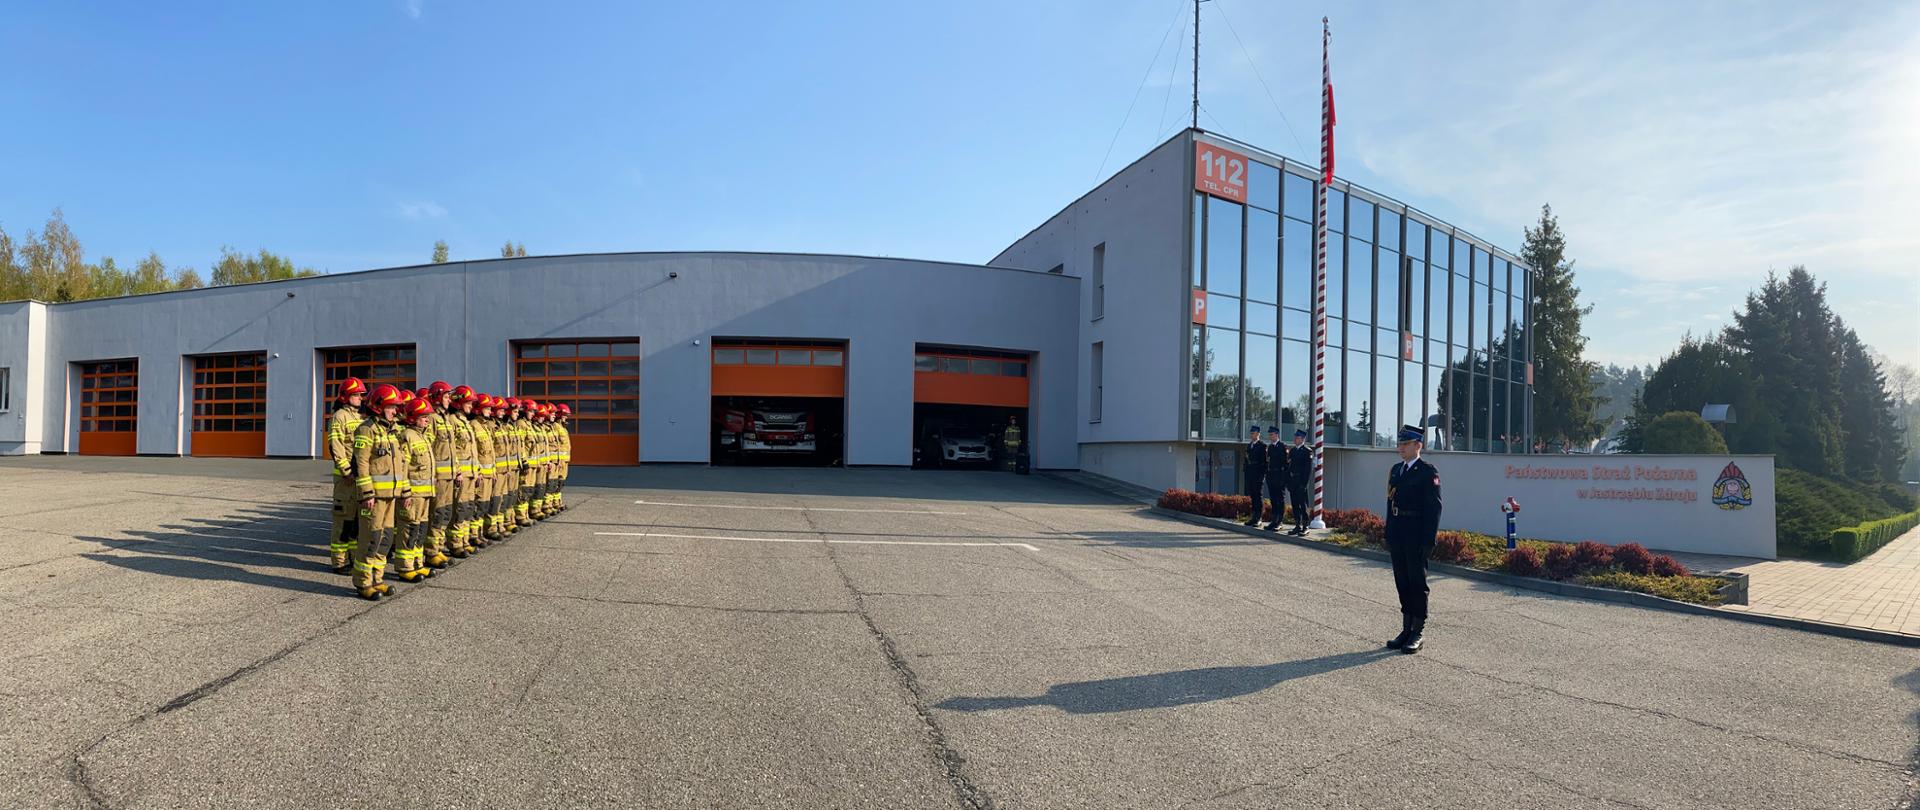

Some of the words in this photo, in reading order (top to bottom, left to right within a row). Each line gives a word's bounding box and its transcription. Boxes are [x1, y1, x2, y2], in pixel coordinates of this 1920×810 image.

[1201, 150, 1244, 187] 112
[1223, 185, 1239, 198] CPR
[1195, 298, 1205, 315] P
[1406, 340, 1412, 353] P
[1505, 464, 1588, 480] Państwowa
[1592, 464, 1631, 480] Straż
[1635, 464, 1697, 480] Pożarna
[1576, 489, 1587, 498] w
[1589, 487, 1654, 502] Jastrzębiu
[1656, 487, 1697, 503] Zdroju
